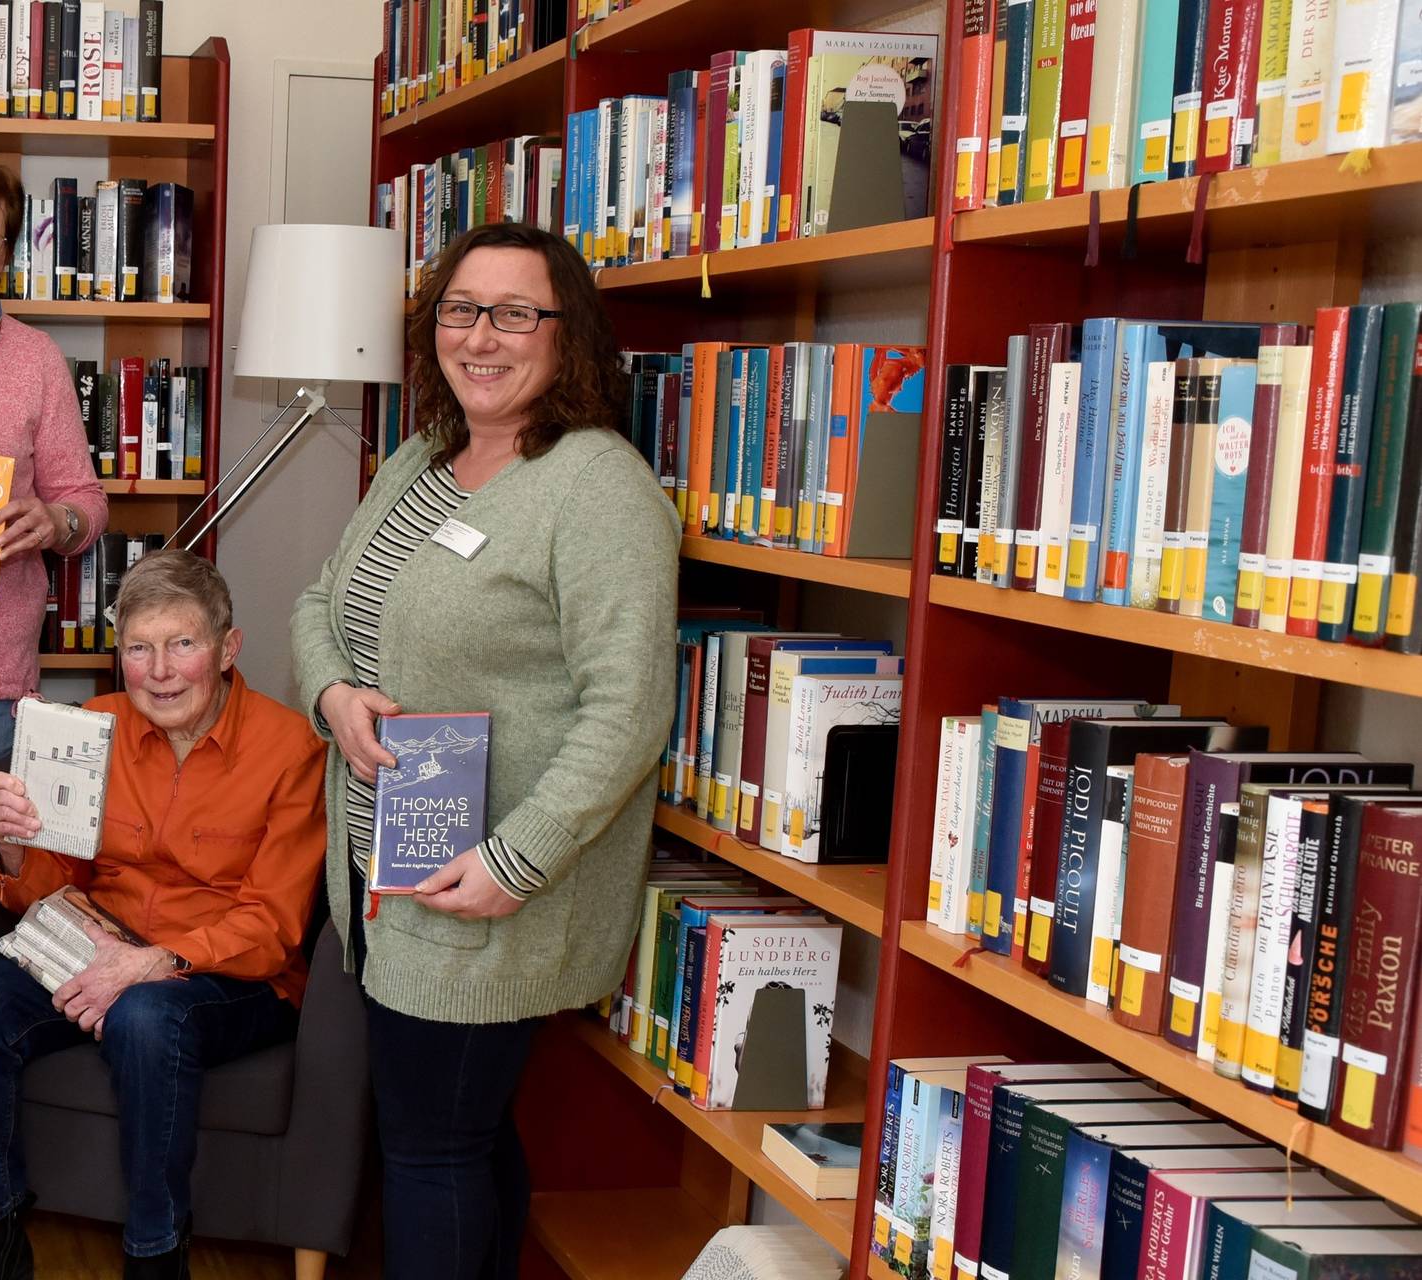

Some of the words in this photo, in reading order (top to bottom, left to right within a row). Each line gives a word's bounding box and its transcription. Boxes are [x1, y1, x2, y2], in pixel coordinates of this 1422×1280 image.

[825, 40, 864, 49] MARIAN
[869, 42, 925, 51] IZAGUIRRE
[1216, 8, 1233, 68] Morton
[83, 32, 101, 96] ROSE
[856, 75, 869, 83] Roy
[870, 75, 899, 84] Jacobsen
[1041, 59, 1053, 68] btb
[854, 89, 866, 97] Der
[1214, 64, 1231, 99] Kate
[82, 208, 91, 251] AMNESIE
[784, 363, 793, 400] NACHT
[1120, 386, 1128, 408] UNS
[82, 400, 90, 421] KIND
[949, 398, 957, 437] HANNI
[978, 402, 986, 440] HANNI
[990, 385, 1002, 444] NADAL
[1154, 394, 1163, 426] Liebe
[1340, 394, 1351, 426] Olsson
[1058, 412, 1066, 446] Nicholls
[1222, 422, 1237, 434] ICH
[1312, 423, 1320, 450] LINDA
[1338, 429, 1347, 454] Linda
[1218, 440, 1250, 451] WALTER
[1347, 438, 1355, 454] DIE
[945, 446, 962, 517] Honigtot
[1310, 463, 1327, 475] btb
[1337, 463, 1352, 475] btb
[1143, 474, 1155, 539] Elizabeth
[1154, 489, 1163, 527] Noble
[707, 655, 717, 712] HOFFNUNG
[820, 685, 868, 704] Judith
[799, 687, 808, 715] Lennox
[795, 717, 805, 756] Judith
[944, 740, 954, 774] OHNE
[942, 777, 951, 806] TAGE
[1067, 769, 1076, 788] EIN
[1074, 765, 1093, 821] JODI
[389, 797, 469, 812] THOMAS
[1064, 791, 1074, 815] LIED
[1133, 796, 1148, 806] JODI
[1149, 798, 1178, 812] PICOULT
[1134, 811, 1173, 827] NEUNZEHN
[1204, 783, 1216, 833] Geschichte
[384, 812, 470, 827] HETTCHE
[404, 828, 449, 842] HERZ
[1135, 822, 1169, 834] MINUTEN
[396, 844, 454, 858] FADEN
[1203, 835, 1211, 850] der
[1305, 837, 1321, 871] LEUTE
[1330, 814, 1343, 863] Osteroth
[1366, 834, 1414, 856] PETER
[1059, 841, 1069, 872] MEINE
[1199, 852, 1209, 876] Ende
[1362, 852, 1420, 878] PRANGE
[1062, 828, 1087, 934] PICOULT
[1197, 878, 1206, 894] ans
[1262, 828, 1280, 930] PHANTASIE
[1325, 866, 1338, 915] Reinhard
[1055, 875, 1066, 926] TOCHTER
[1195, 896, 1204, 909] Bis
[1298, 873, 1316, 923] ANDERER
[752, 936, 809, 948] SOFIA
[1259, 934, 1267, 953] DIE
[1278, 922, 1288, 945] DER
[1354, 899, 1385, 979] Emily
[728, 951, 832, 962] LUNDBERG
[738, 967, 755, 977] Ein
[757, 966, 791, 977] halbes
[792, 967, 819, 977] Herz
[1252, 970, 1266, 1024] Judith
[1265, 964, 1282, 1018] Pinnow
[1311, 923, 1338, 1034] PORSCHE
[1368, 934, 1403, 1032] Paxton
[882, 1102, 895, 1158] ROBERTS
[902, 1117, 915, 1173] ROBERTS
[941, 1130, 954, 1184] ROBERTS
[879, 1158, 889, 1195] NORA
[899, 1175, 909, 1212] NORA
[937, 1187, 948, 1227] NORA
[1075, 1163, 1092, 1226] PERLEN
[1082, 1181, 1100, 1250] Schwester
[1147, 1189, 1166, 1259] ROBERTS
[1213, 1224, 1224, 1260] WELLEN
[1144, 1262, 1155, 1280] RA
